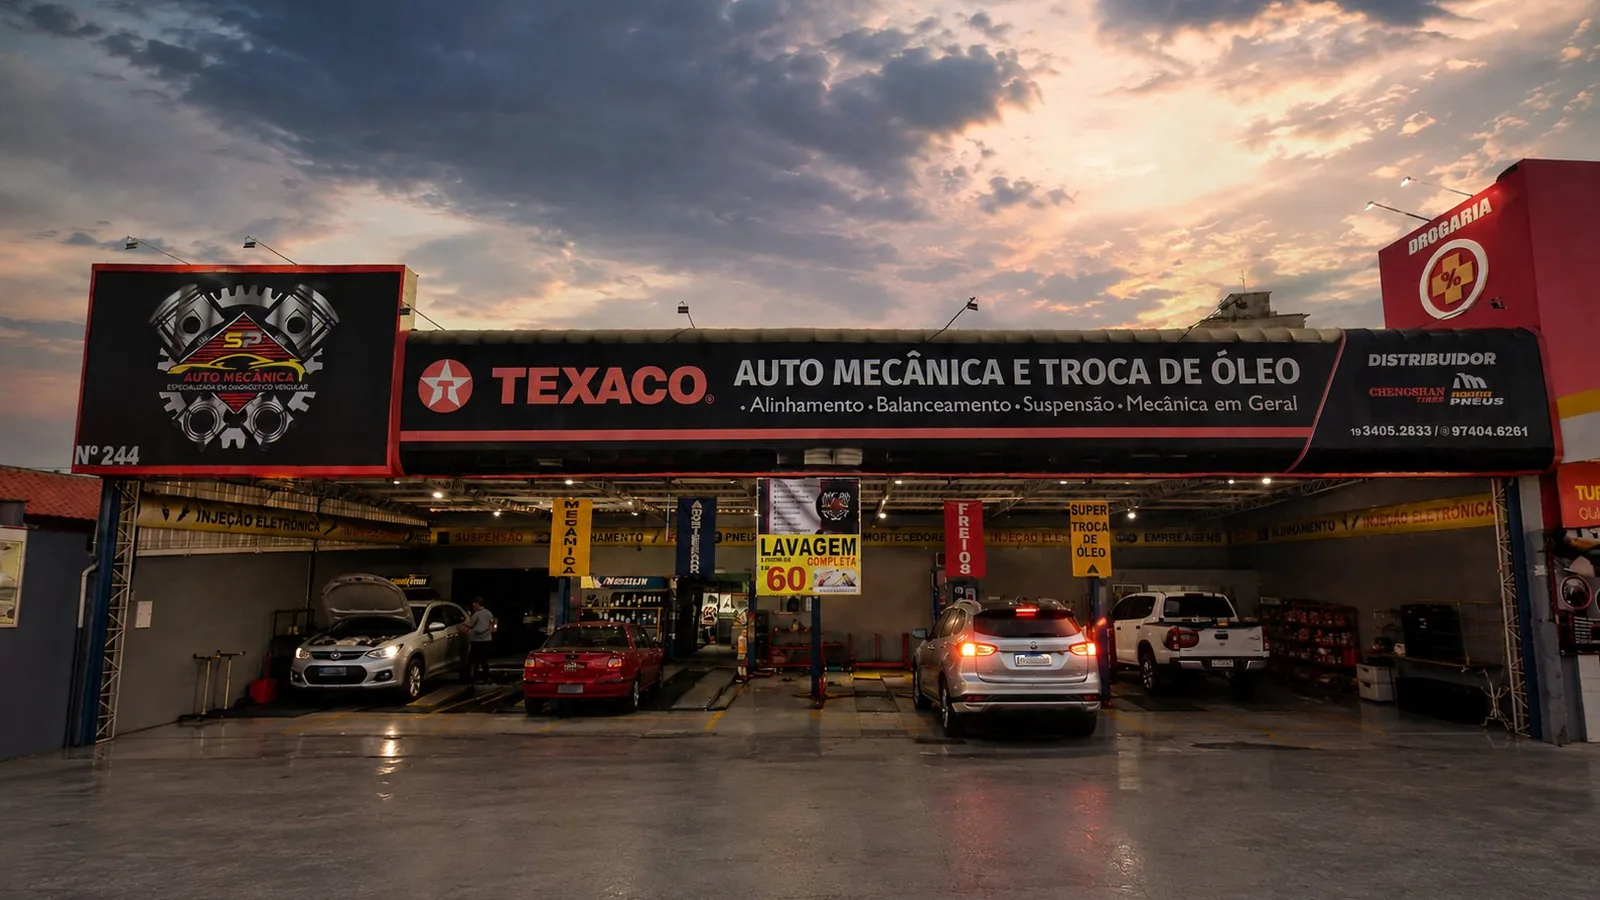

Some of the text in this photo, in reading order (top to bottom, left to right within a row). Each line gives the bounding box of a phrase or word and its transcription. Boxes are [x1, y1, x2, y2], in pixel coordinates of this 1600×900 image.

[1408, 197, 1492, 256] DROGARIA
[223, 331, 263, 349] SP
[1368, 352, 1496, 367] DISTRIBUIDOR
[733, 350, 1300, 386] AUTO MECÂNICA E TROCA DE ÓLEO
[183, 369, 294, 383] AUTO MECÂNICA
[492, 365, 708, 405] TEXACO
[1368, 387, 1445, 398] CHENGSHAN
[750, 395, 1298, 417] Alinhamento Balanceamento Suspensão Mecânica em Geral
[1450, 397, 1504, 406] PNEUS
[1363, 425, 1432, 436] 3405.2833
[1451, 426, 1528, 437] 97404.6261
[101, 446, 140, 466] 244
[1071, 504, 1108, 516] SUPER
[195, 509, 254, 530] INJEÇÃO
[1071, 521, 1109, 533] TROCA
[591, 532, 644, 543] HAMENTO
[863, 532, 945, 543] MORTECEDORE
[958, 502, 971, 575] FREIOS
[1083, 534, 1097, 544] DE
[761, 538, 857, 556] LAVAGEM
[1076, 544, 1106, 558] ÓLEO
[806, 556, 857, 567] COMPLETA
[766, 565, 806, 592] 60
